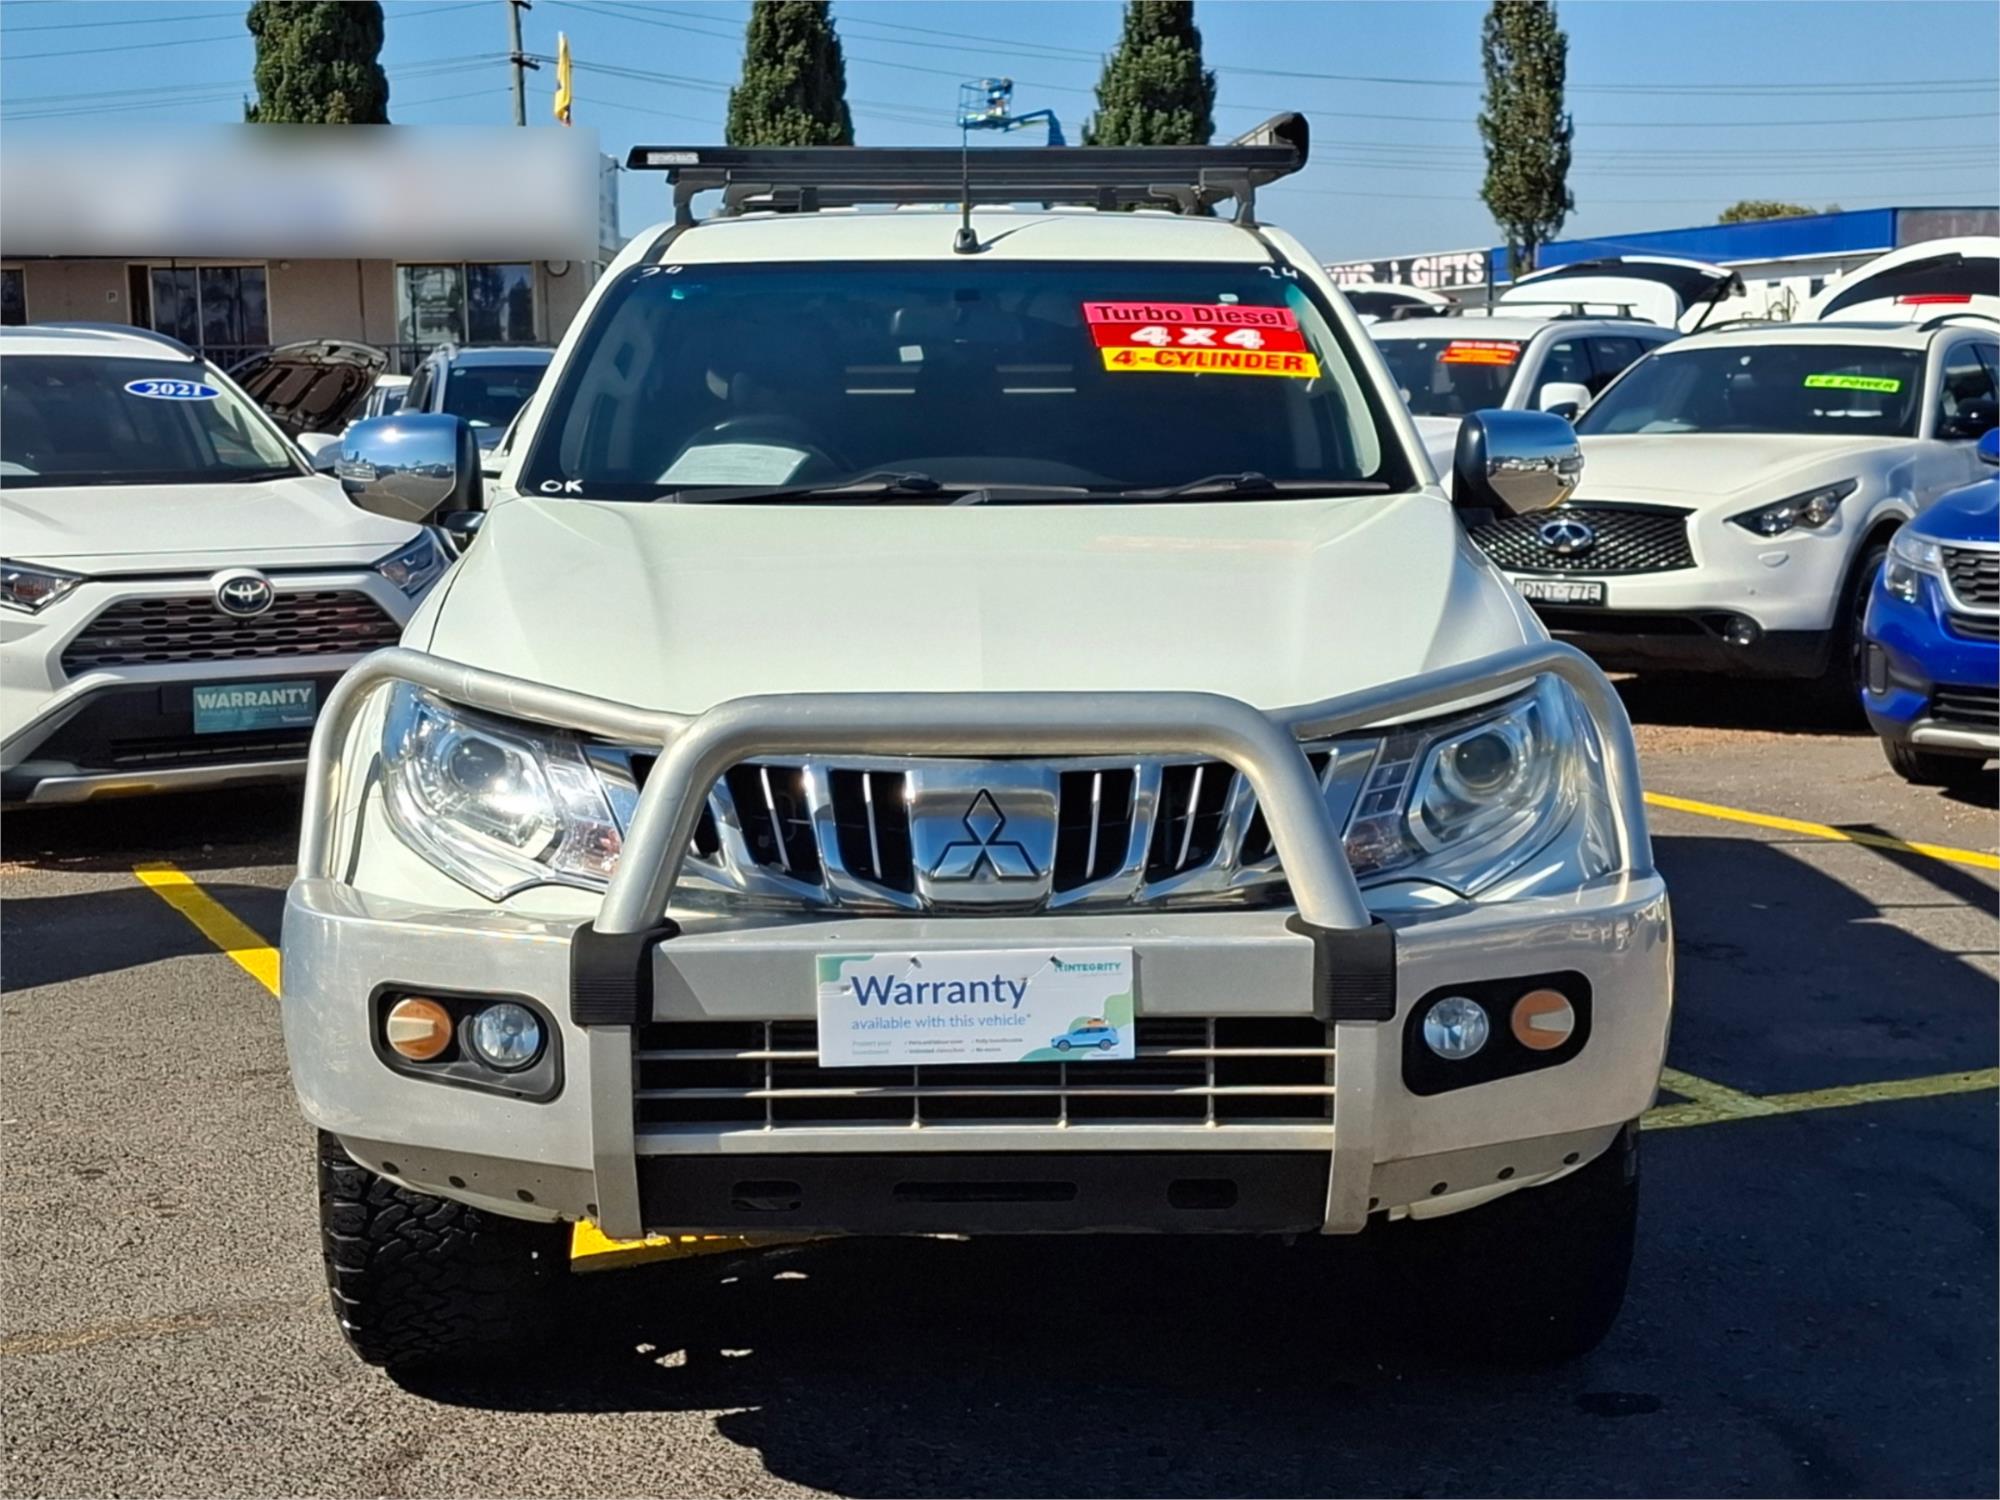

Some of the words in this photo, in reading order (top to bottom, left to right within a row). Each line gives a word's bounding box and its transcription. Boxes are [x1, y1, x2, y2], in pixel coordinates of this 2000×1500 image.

[1411, 253, 1484, 288] GIFTS
[1095, 305, 1184, 322] Turbo
[1192, 307, 1288, 326] Diesel
[1112, 350, 1304, 371] 4-CYLINDER
[143, 382, 202, 397] 2021
[539, 478, 584, 493] OK
[196, 687, 312, 710] WARRANTY
[1064, 962, 1121, 972] INTEGRITY
[851, 973, 1028, 1009] Warranty
[851, 1016, 912, 1030] available
[914, 1015, 946, 1028] with
[950, 1014, 974, 1027] this
